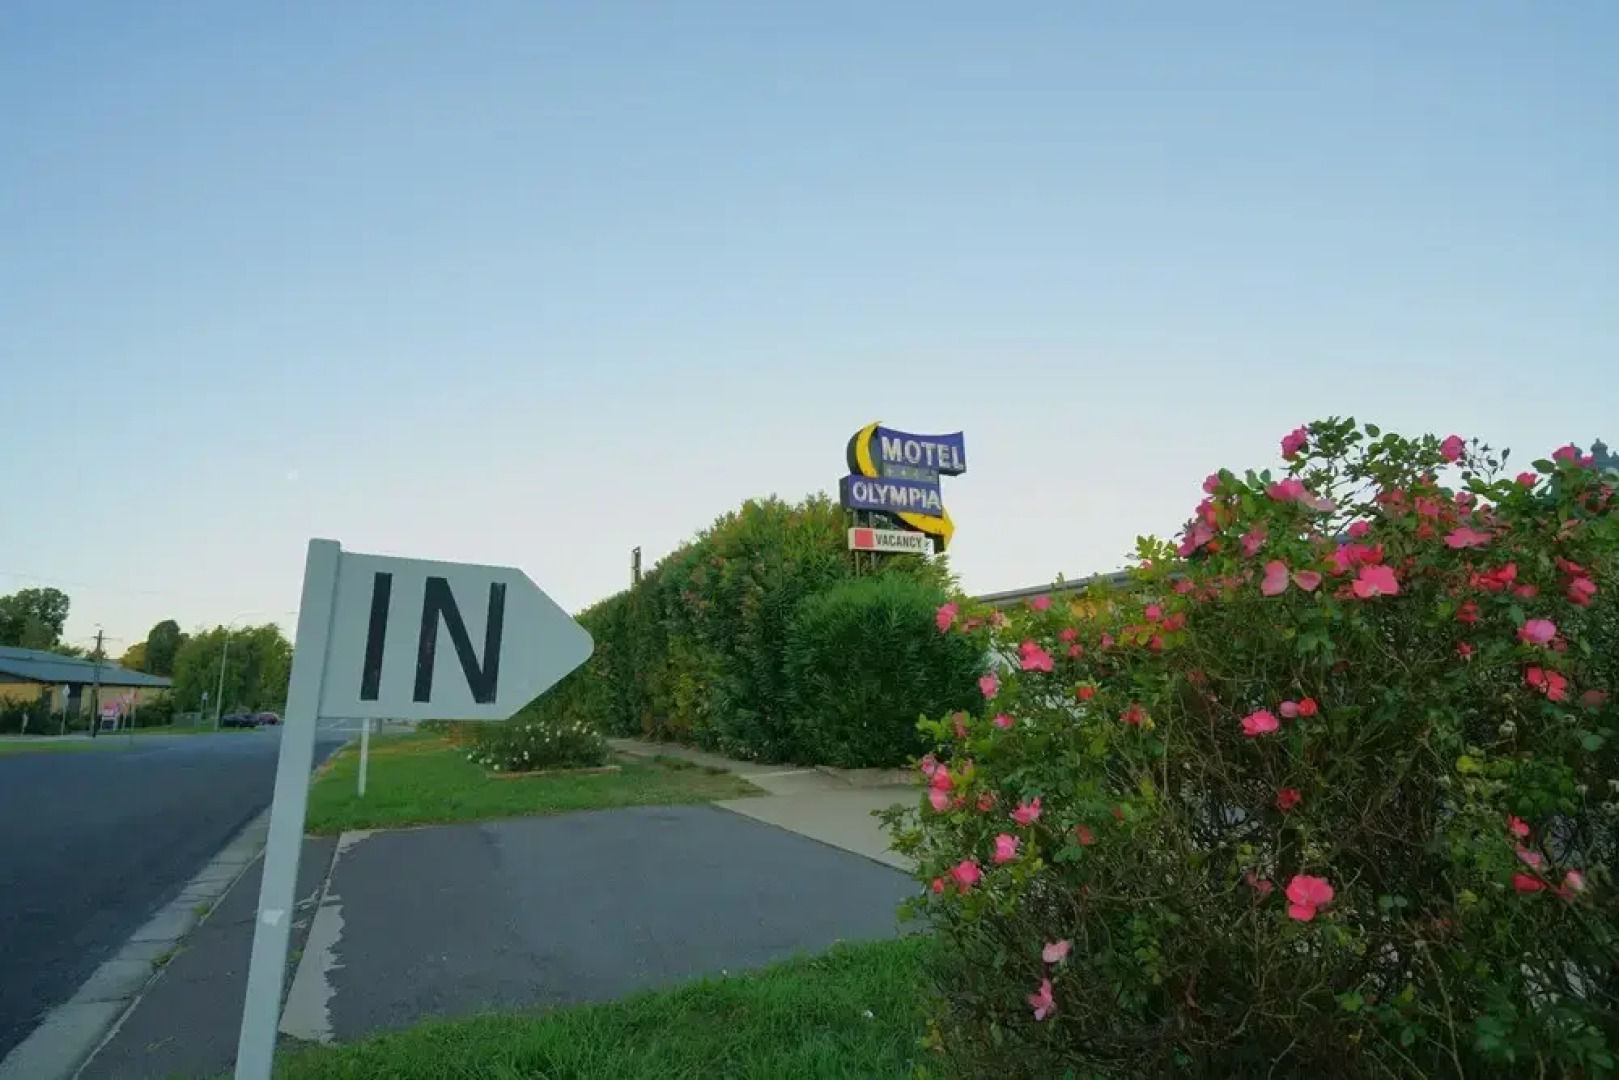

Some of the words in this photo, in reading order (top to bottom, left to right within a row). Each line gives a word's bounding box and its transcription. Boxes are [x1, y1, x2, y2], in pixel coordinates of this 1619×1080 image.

[881, 436, 964, 469] MOTEL
[852, 481, 941, 510] OLYMPIA
[875, 533, 922, 549] VACANCY
[360, 571, 507, 704] IN
